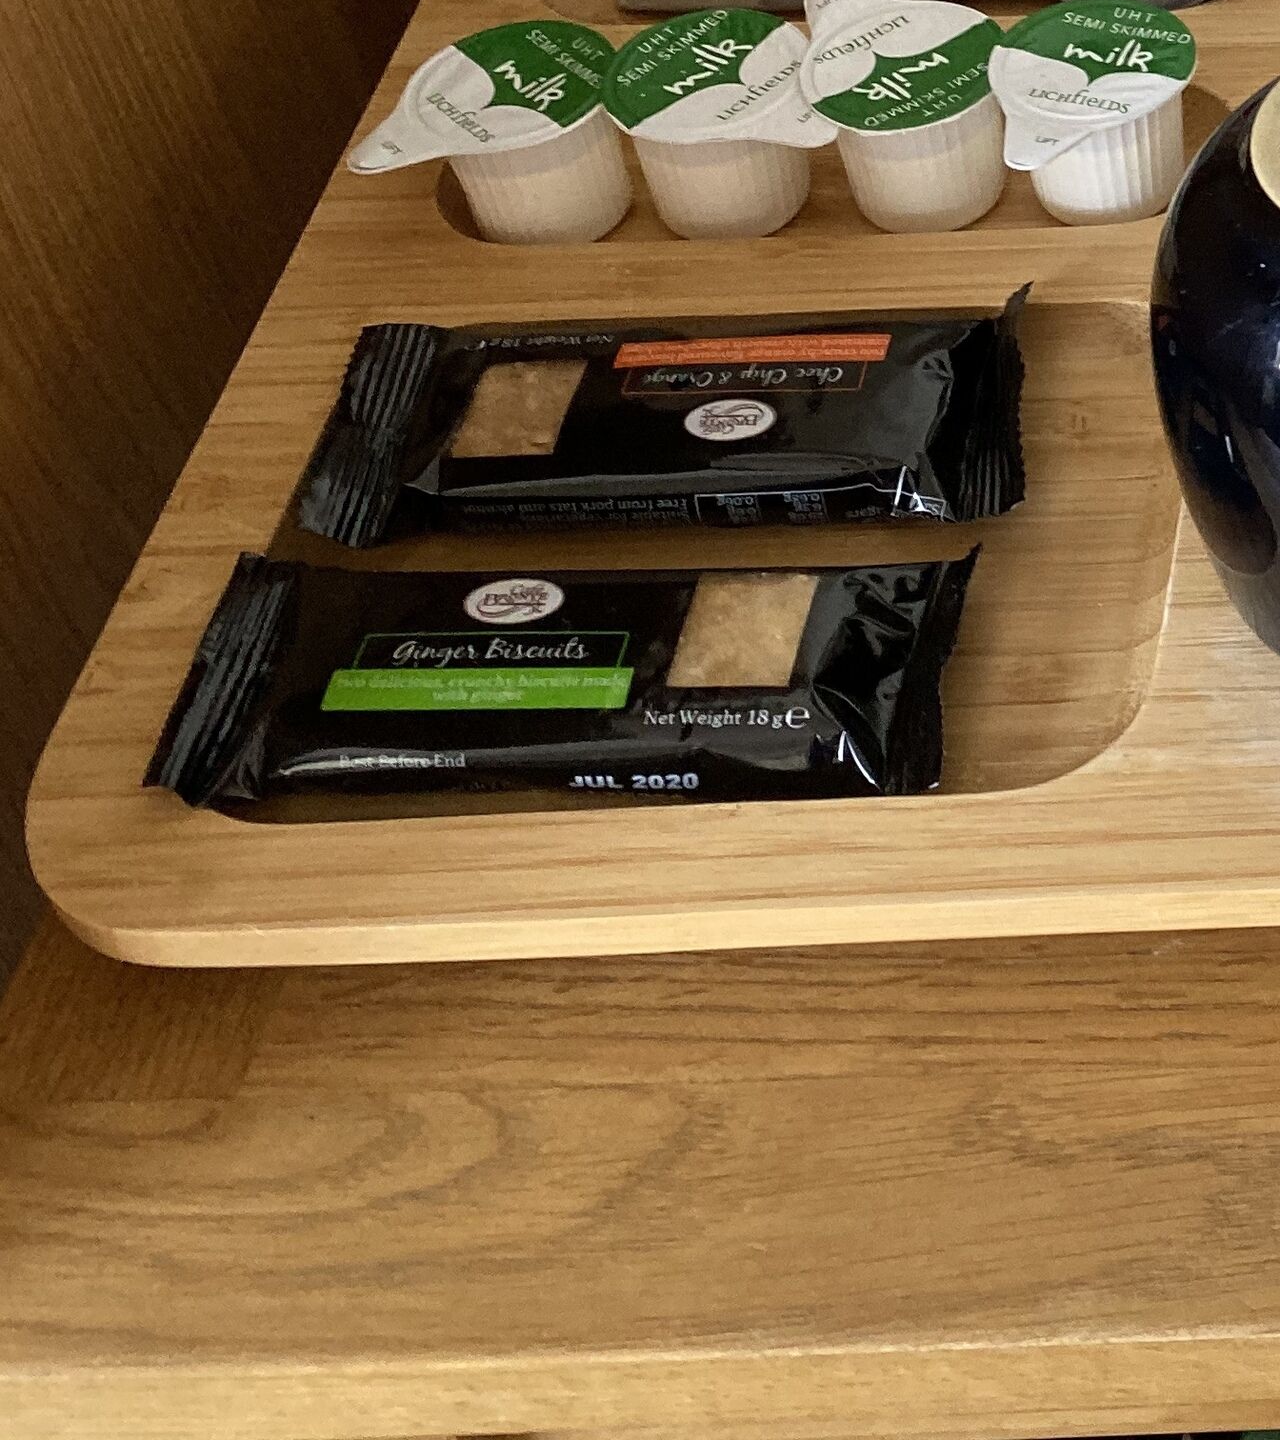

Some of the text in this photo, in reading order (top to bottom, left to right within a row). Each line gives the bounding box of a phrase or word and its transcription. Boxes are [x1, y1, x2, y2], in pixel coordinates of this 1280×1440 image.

[1061, 11, 1192, 45] SEMI SKIMMED
[1113, 6, 1157, 24] UHT
[571, 36, 606, 61] UHT
[616, 9, 729, 87] SEMI SKIMMED
[637, 26, 676, 55] UHT
[662, 38, 755, 96] milk
[1063, 38, 1155, 73] milk
[493, 59, 567, 112] milk
[851, 51, 950, 101] milk
[863, 61, 990, 128] SEMI SKIMMED
[921, 93, 964, 118] UHT
[717, 367, 733, 385] &
[739, 367, 788, 388] Chip
[796, 366, 843, 386] Choc
[392, 636, 590, 668] Ginger Biscuits
[643, 709, 676, 726] Net
[679, 709, 742, 729] Weight
[434, 753, 466, 768] End
[568, 772, 699, 790] JUL 2020
